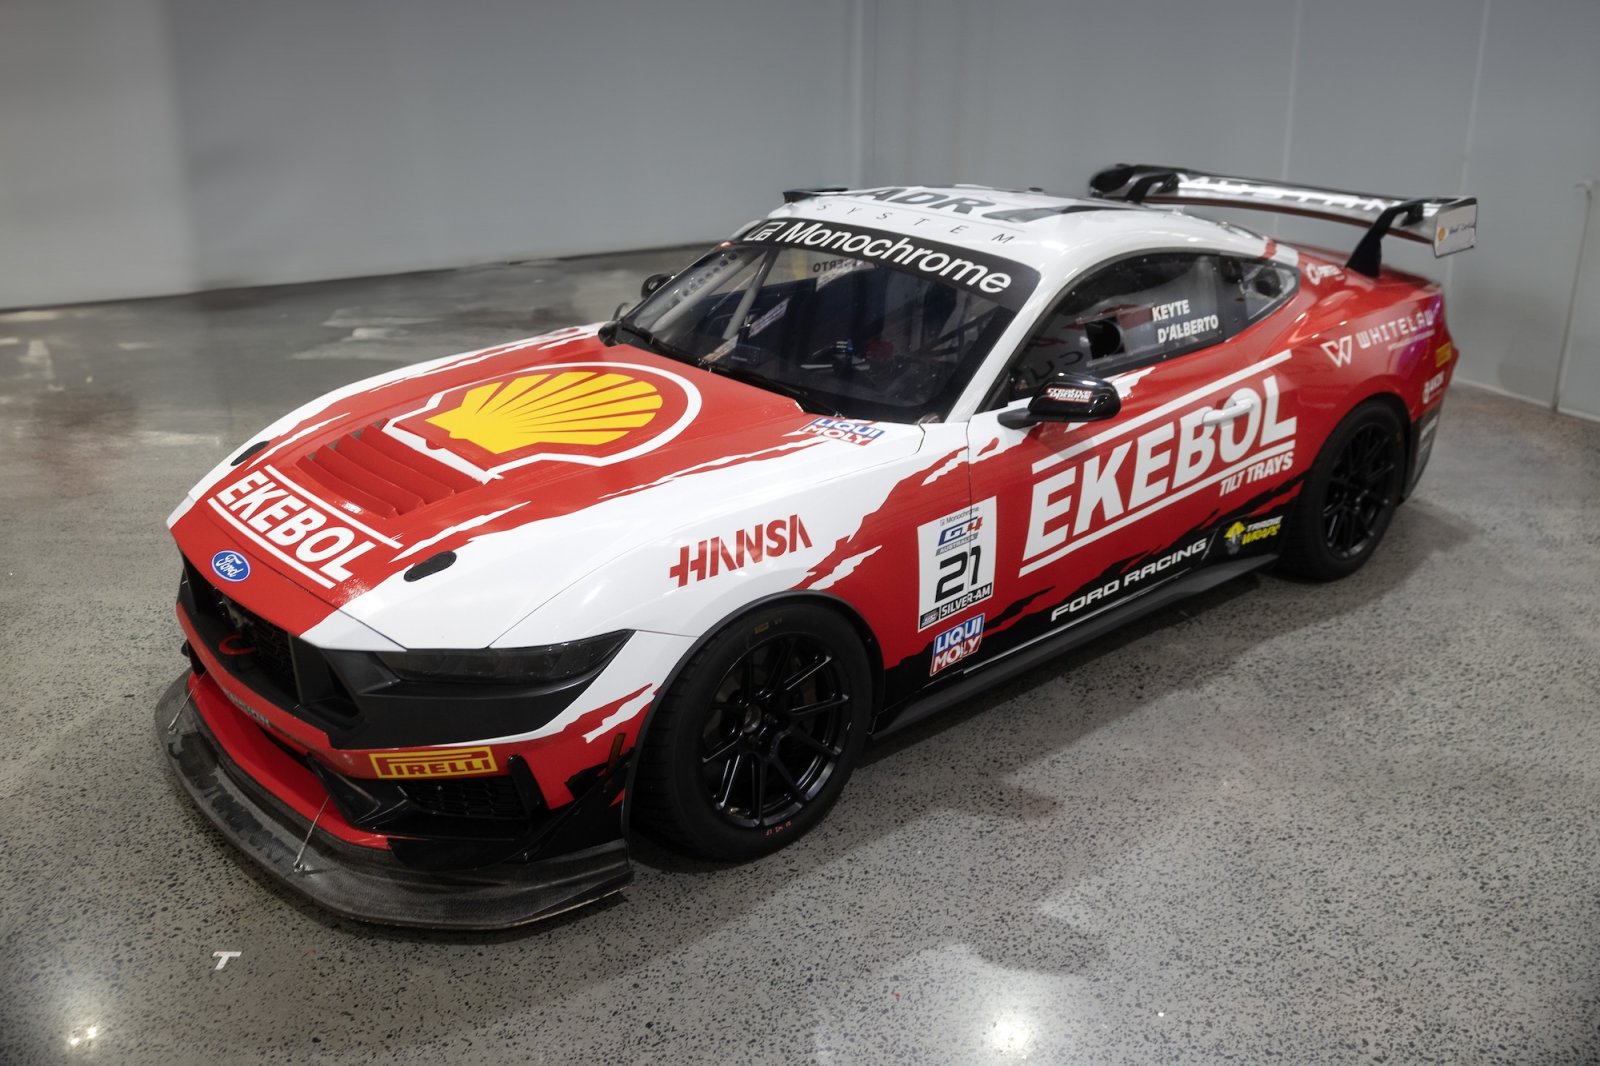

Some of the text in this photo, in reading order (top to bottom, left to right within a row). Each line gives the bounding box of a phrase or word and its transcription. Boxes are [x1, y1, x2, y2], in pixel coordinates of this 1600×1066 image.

[816, 202, 1015, 244] SYSTEM
[775, 222, 1011, 293] Monochrome
[1152, 300, 1190, 322] KEYTE
[1158, 315, 1219, 344] D'ALBERTO
[803, 425, 873, 444] MOLY
[813, 418, 882, 438] LIQUI
[1023, 376, 1297, 561] EKEBOL
[1219, 451, 1294, 497] TILT TRAYS
[216, 470, 377, 583] EKEBOL
[215, 554, 244, 577] Ford
[669, 514, 813, 588] HANSA
[935, 545, 981, 603] 21
[1051, 538, 1208, 622] FORD RACING
[942, 590, 991, 617] SILVER-AM
[936, 616, 983, 652] LIQUI
[933, 636, 981, 673] MOLY
[375, 750, 491, 776] PIRELLI
